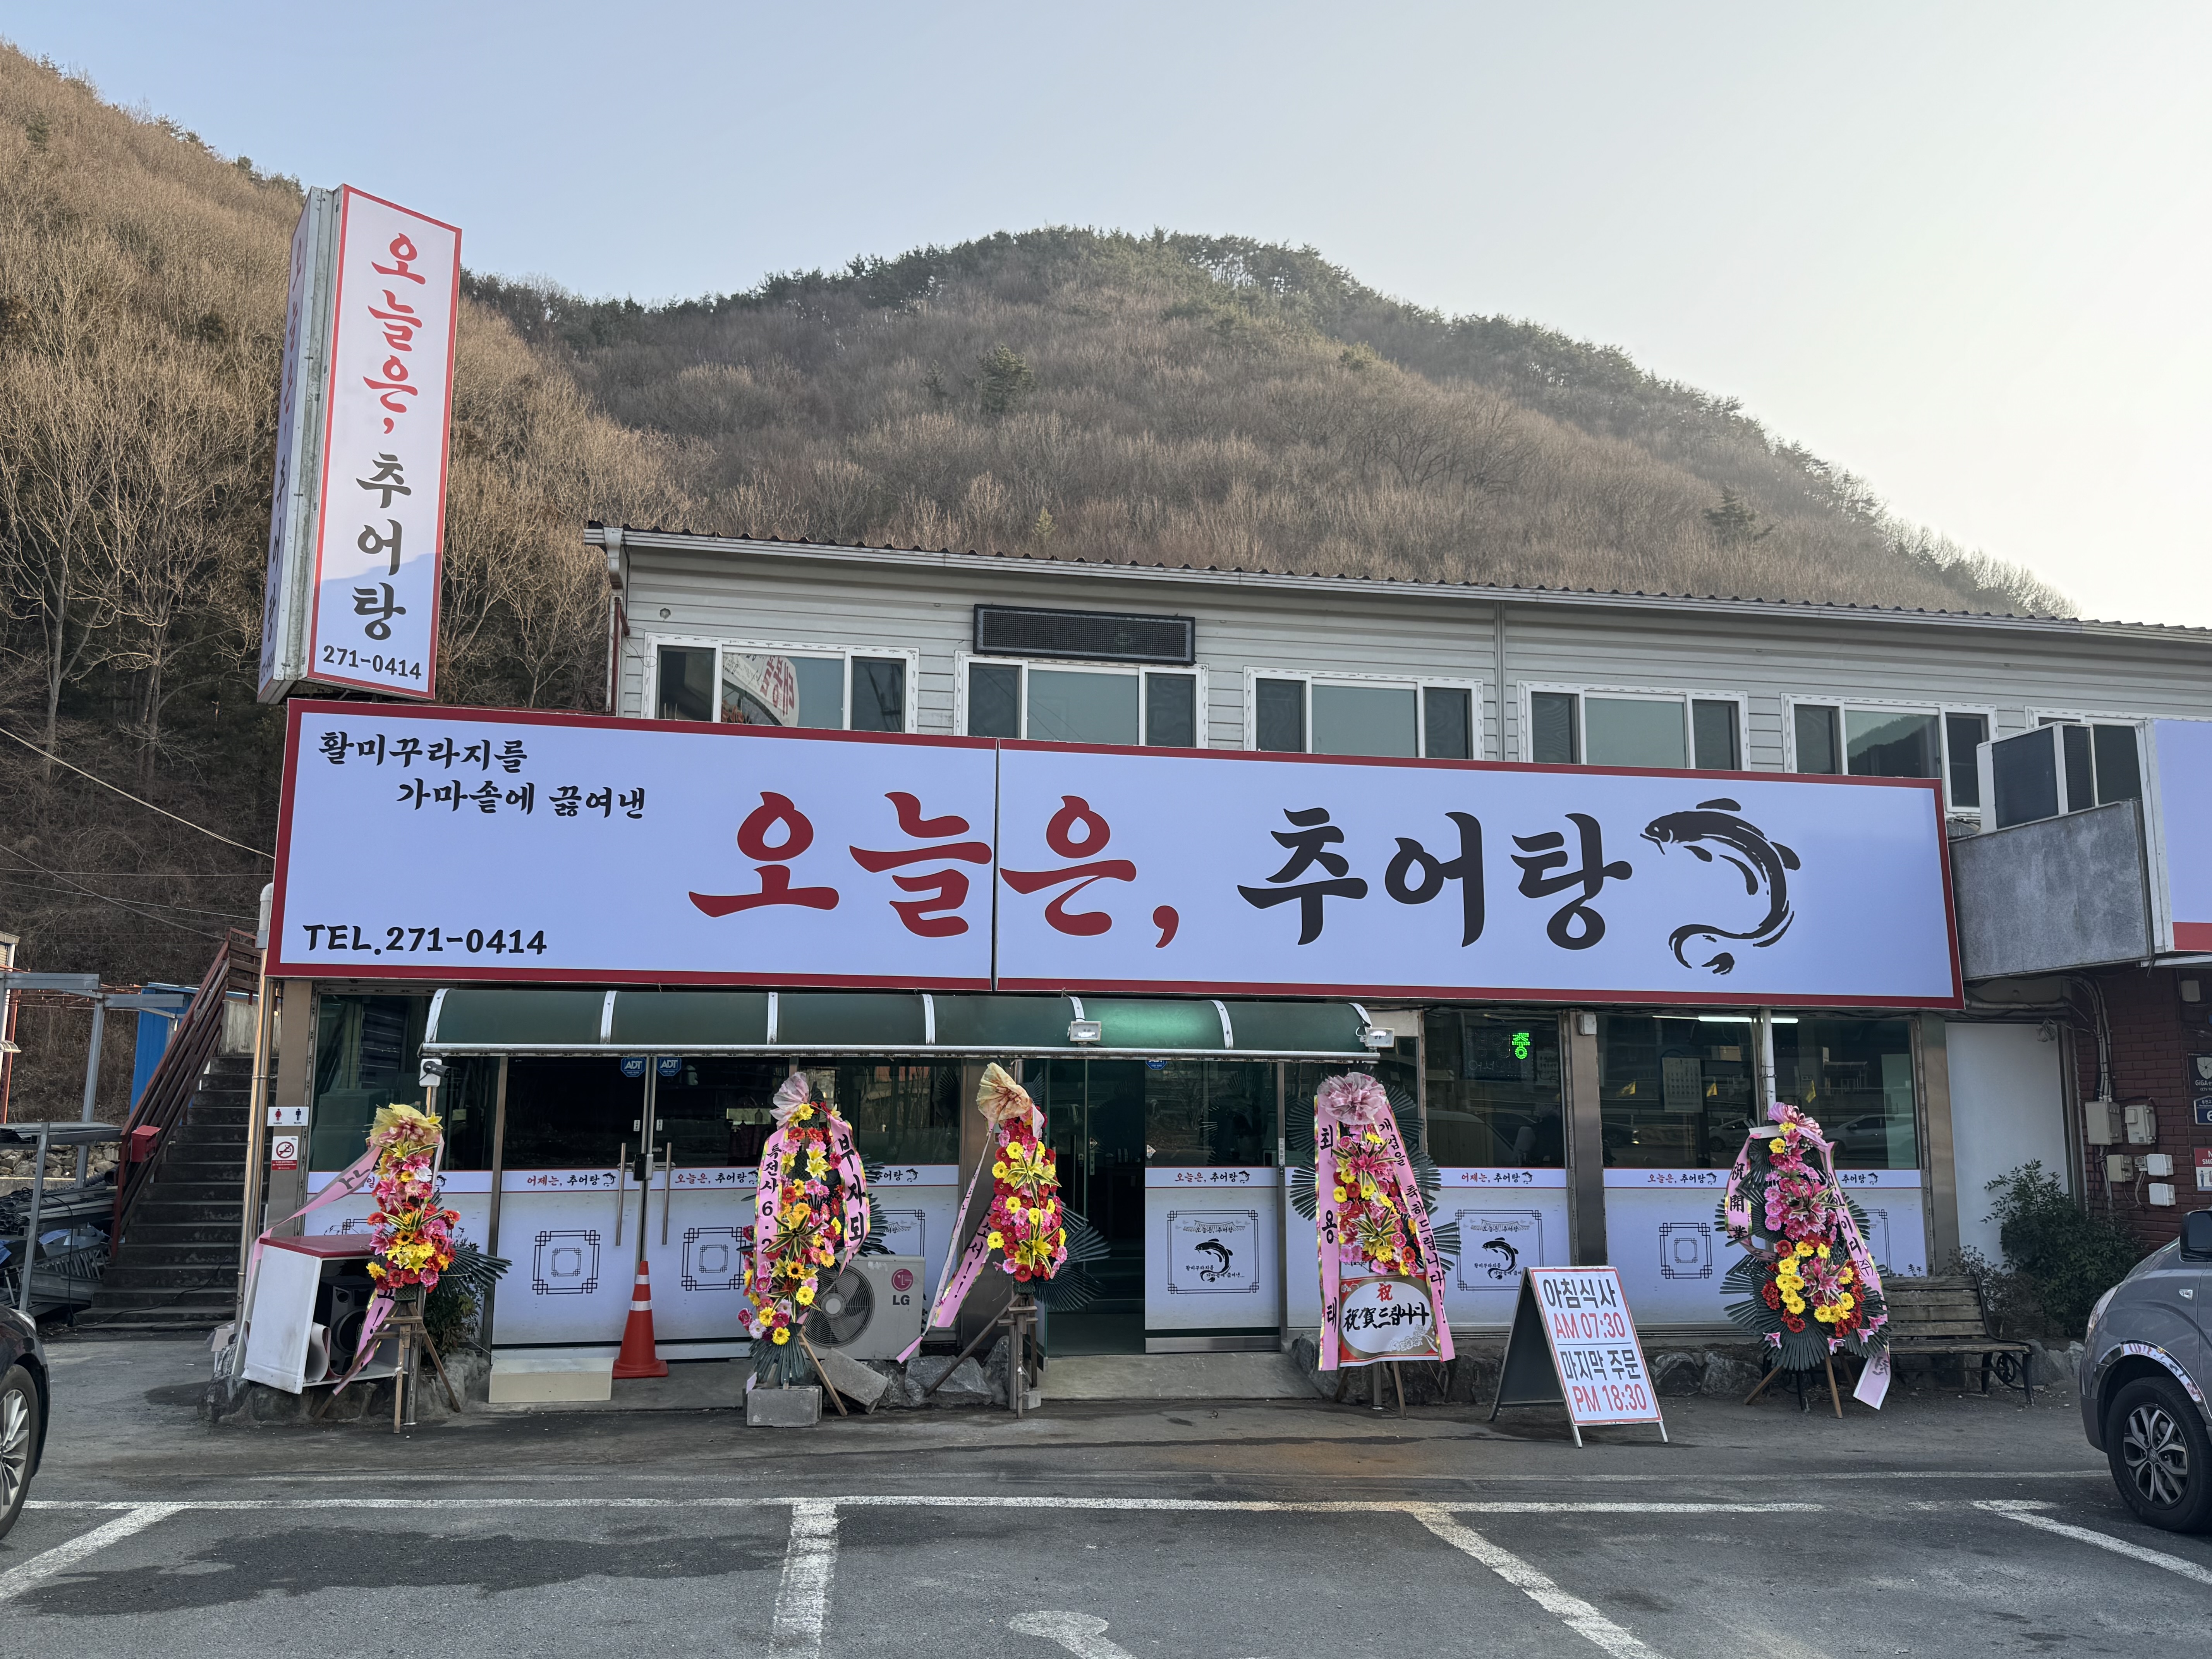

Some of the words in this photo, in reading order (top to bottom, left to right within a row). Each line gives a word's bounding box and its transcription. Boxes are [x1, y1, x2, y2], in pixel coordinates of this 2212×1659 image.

[363, 232, 426, 434] 오늘은,
[352, 452, 412, 641] 추어탕
[323, 644, 421, 680] 271-0414
[318, 731, 527, 773] 활미꾸라지를
[397, 778, 535, 814] 가마솥에
[549, 785, 646, 819] 끓여낸
[689, 792, 1179, 948] 오늘은,
[1237, 807, 1633, 950] 추어탕
[303, 925, 547, 955] TEL.271-0414
[1511, 1032, 1530, 1060] 중
[624, 1061, 642, 1069] ADT
[660, 1060, 678, 1068] ADT
[1379, 1118, 1405, 1166] 개업을
[527, 1175, 562, 1187] 어제는,
[567, 1174, 600, 1186] 추어탕
[675, 1172, 711, 1184] 오늘은,
[715, 1171, 747, 1183] 추어탕
[760, 1143, 782, 1194] 특전사
[1175, 1172, 1206, 1183] 오늘은,
[1210, 1172, 1238, 1182] 추어탕
[1461, 1172, 1491, 1183] 어제는,
[1494, 1173, 1520, 1183] 추어탕
[1647, 1173, 1677, 1183] 오늘은,
[1680, 1173, 1706, 1183] 추어탕
[1841, 1174, 1866, 1183] 추어탕
[838, 1133, 866, 1262] 부자되
[1320, 1124, 1338, 1333] 최용태
[893, 1295, 910, 1305] LG
[1377, 1283, 1393, 1302] 祝
[1543, 1278, 1616, 1308] 아침식사
[1554, 1313, 1580, 1339] AM
[1581, 1312, 1626, 1339] 07:30
[1560, 1350, 1607, 1381] 마지막
[1607, 1349, 1641, 1380] 주문
[1572, 1386, 1602, 1413] PM
[1602, 1383, 1647, 1412] 18:30
